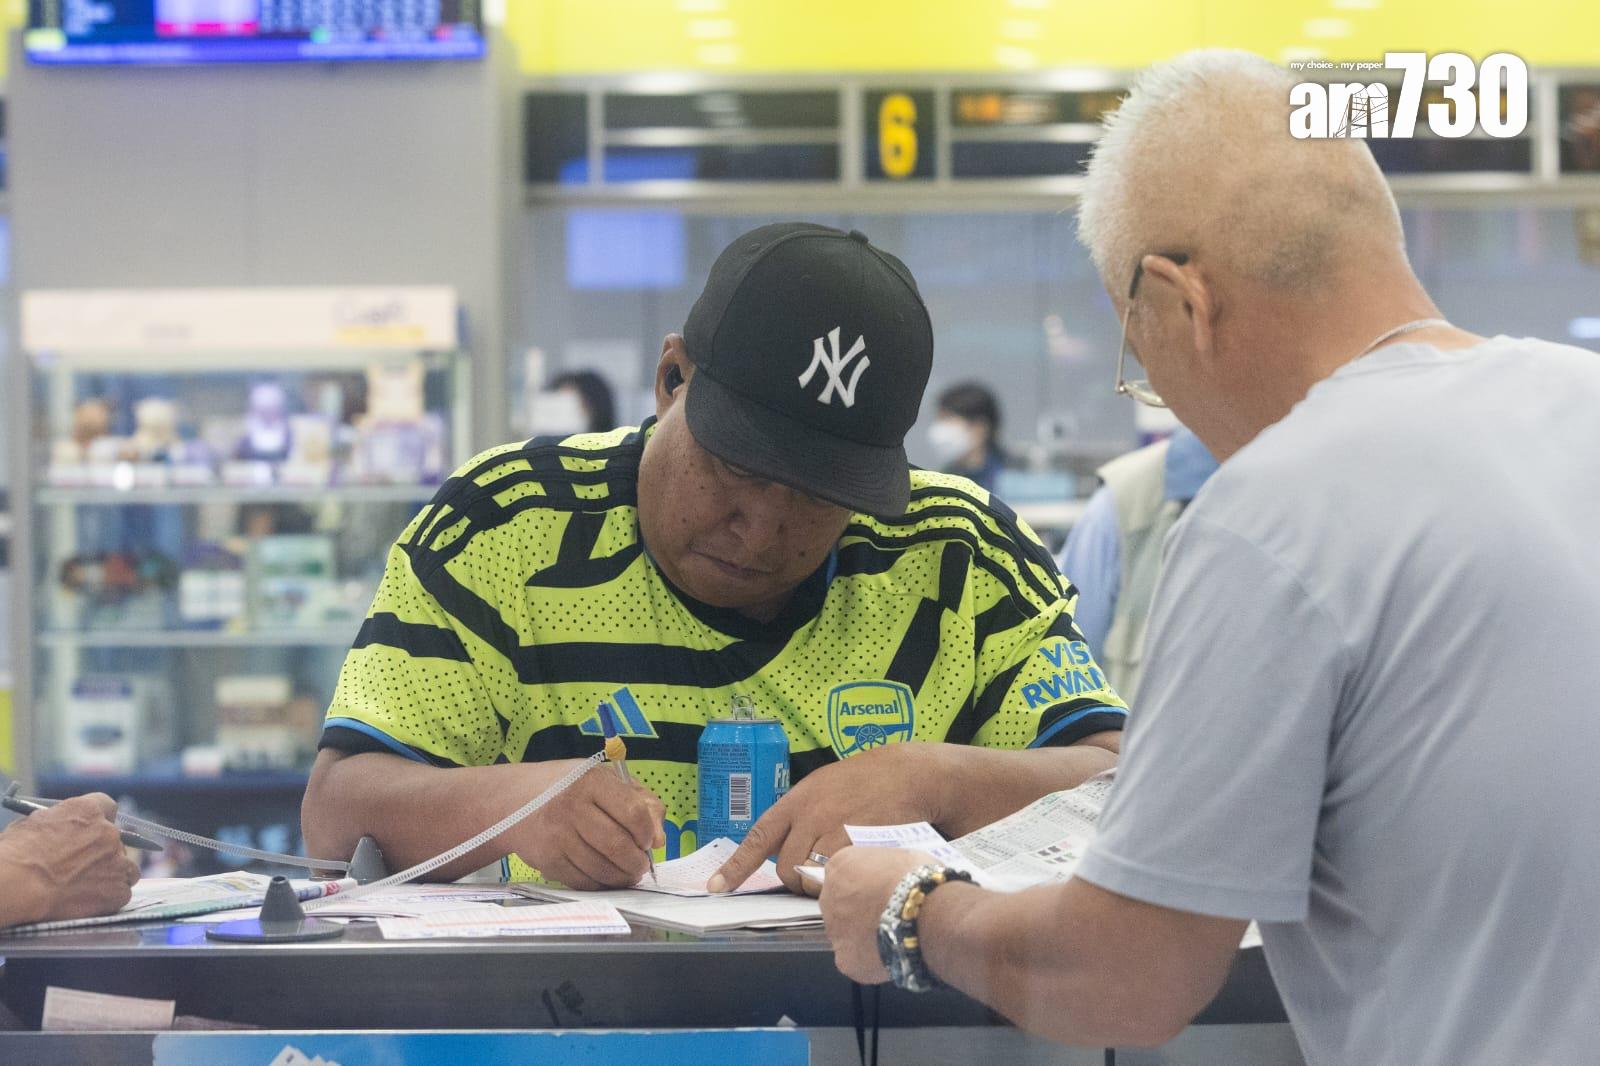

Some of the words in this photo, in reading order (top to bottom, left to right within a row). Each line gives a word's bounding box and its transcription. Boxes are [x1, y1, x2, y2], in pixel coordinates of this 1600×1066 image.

[879, 94, 918, 178] 6
[798, 326, 871, 408] NY
[840, 700, 899, 715] Arsenal
